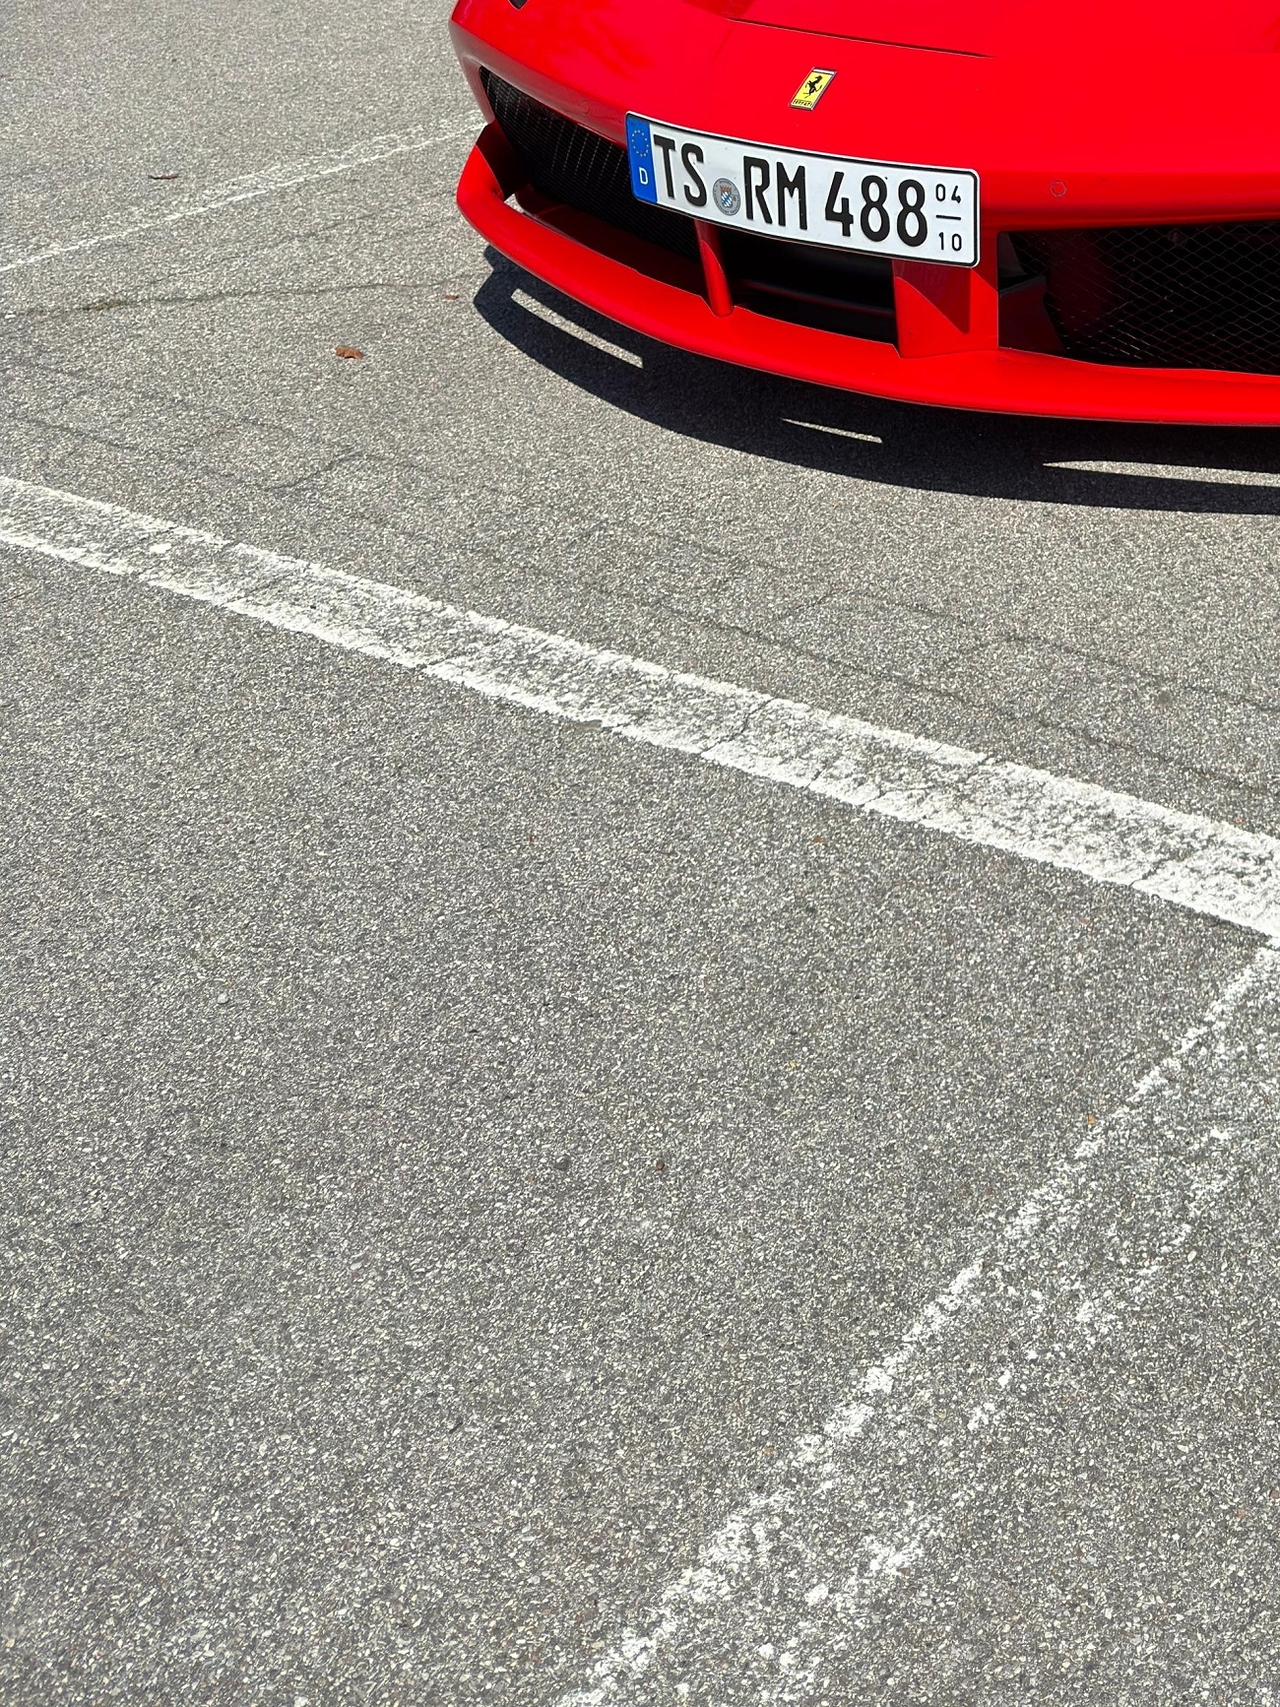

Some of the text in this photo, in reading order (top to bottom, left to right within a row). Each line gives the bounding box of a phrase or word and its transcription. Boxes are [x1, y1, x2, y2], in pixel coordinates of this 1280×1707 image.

[639, 167, 649, 186] D
[653, 133, 708, 207] TS
[743, 155, 808, 230] RM
[825, 171, 928, 247] 488
[935, 183, 962, 204] 04
[938, 232, 962, 252] 10
